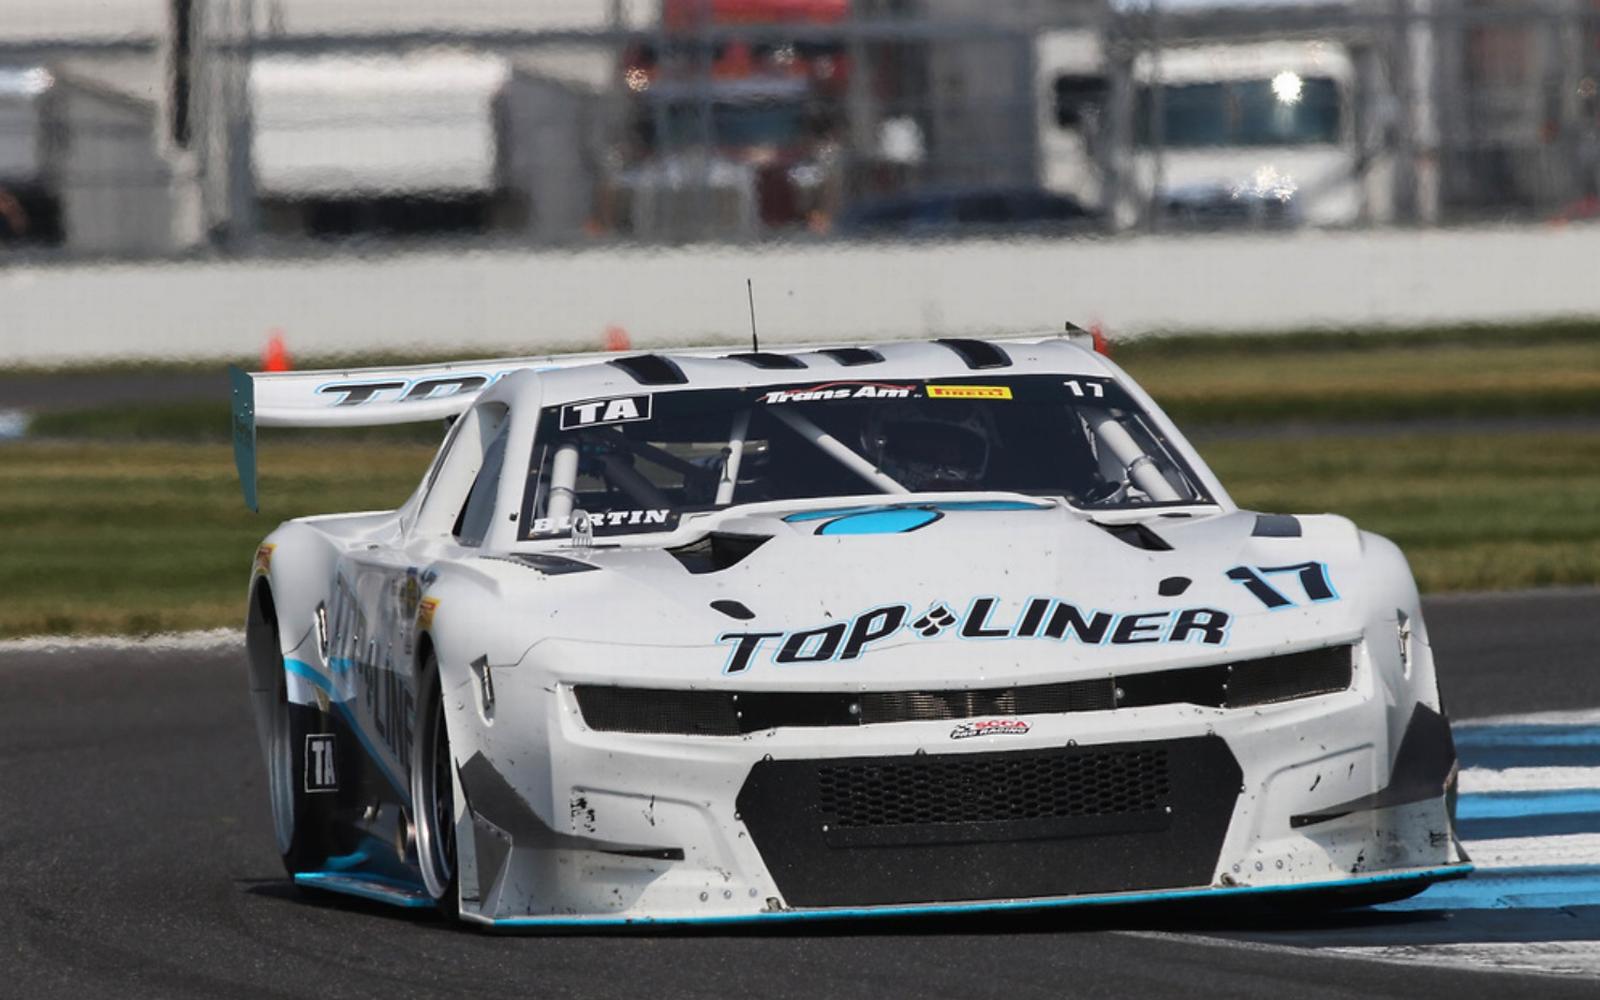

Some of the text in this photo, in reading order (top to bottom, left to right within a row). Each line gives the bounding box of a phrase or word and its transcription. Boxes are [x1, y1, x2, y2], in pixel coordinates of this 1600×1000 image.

[316, 369, 506, 406] TO
[766, 385, 910, 404] Trans Am
[934, 387, 1003, 397] PIRELLI
[1063, 380, 1104, 398] 17
[573, 398, 640, 425] TA
[1224, 561, 1339, 611] 17
[718, 596, 1232, 674] TOP LINER
[951, 728, 1028, 739] PRO RACING
[975, 719, 1027, 729] SCCA
[311, 740, 337, 785] TA
